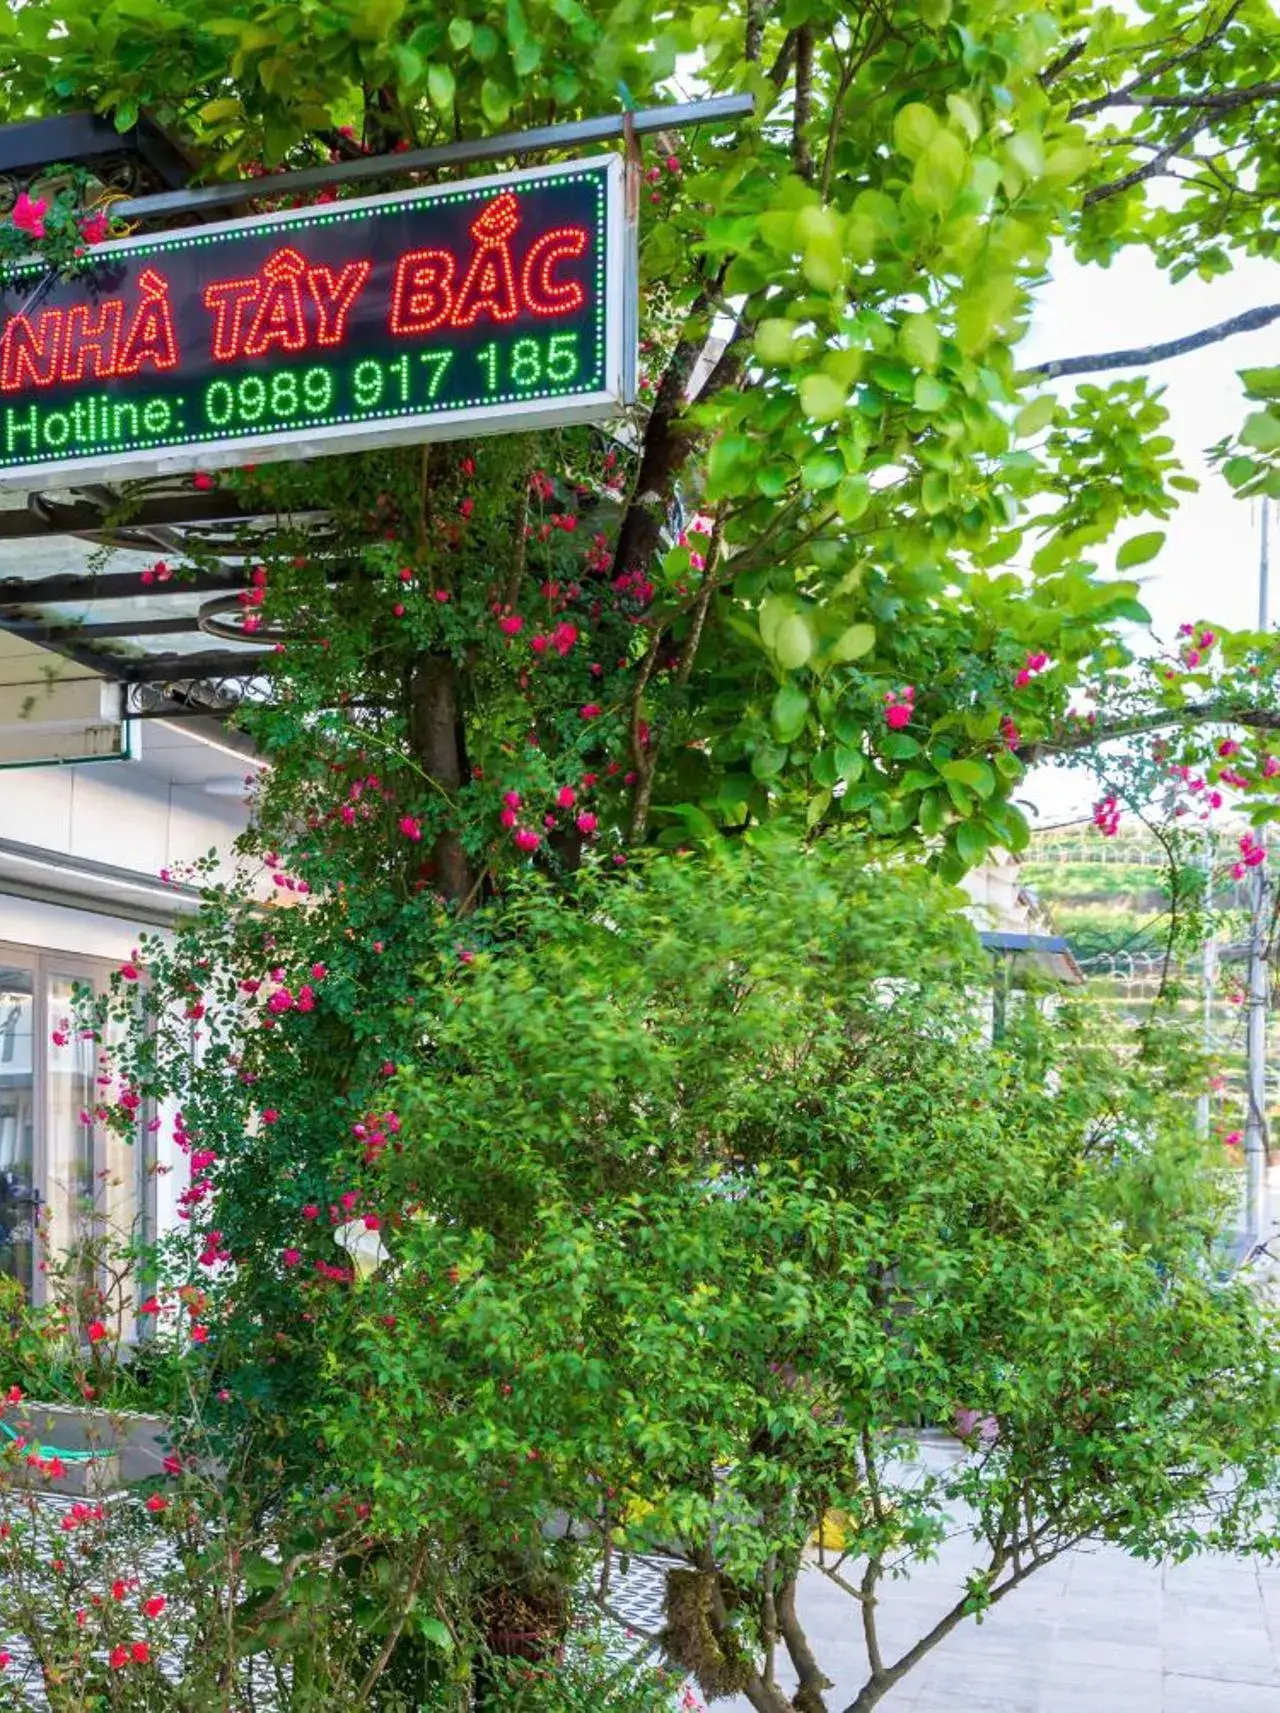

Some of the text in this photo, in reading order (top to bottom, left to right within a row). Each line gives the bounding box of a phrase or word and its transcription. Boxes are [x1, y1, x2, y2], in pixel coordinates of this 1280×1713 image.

[204, 246, 372, 361] TÂY
[390, 192, 588, 334] BẮC
[6, 333, 579, 452] Hotline: 0989 917 185
